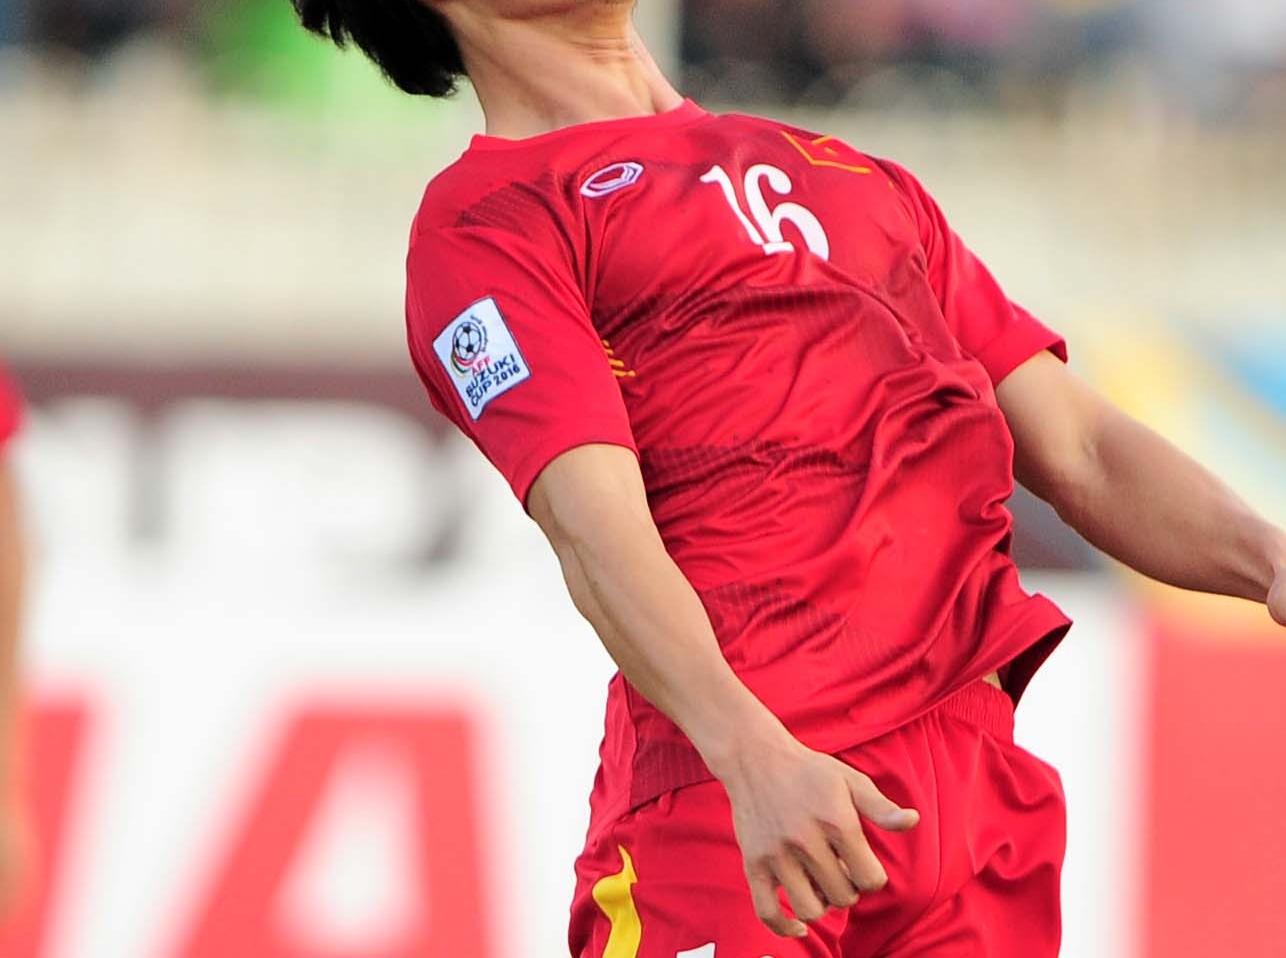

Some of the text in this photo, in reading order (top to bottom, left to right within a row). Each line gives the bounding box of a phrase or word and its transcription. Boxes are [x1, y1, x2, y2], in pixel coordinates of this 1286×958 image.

[699, 163, 830, 262] 16
[465, 354, 516, 398] SUZUKI
[471, 355, 492, 375] AFF
[469, 366, 520, 407] CUP 2016
